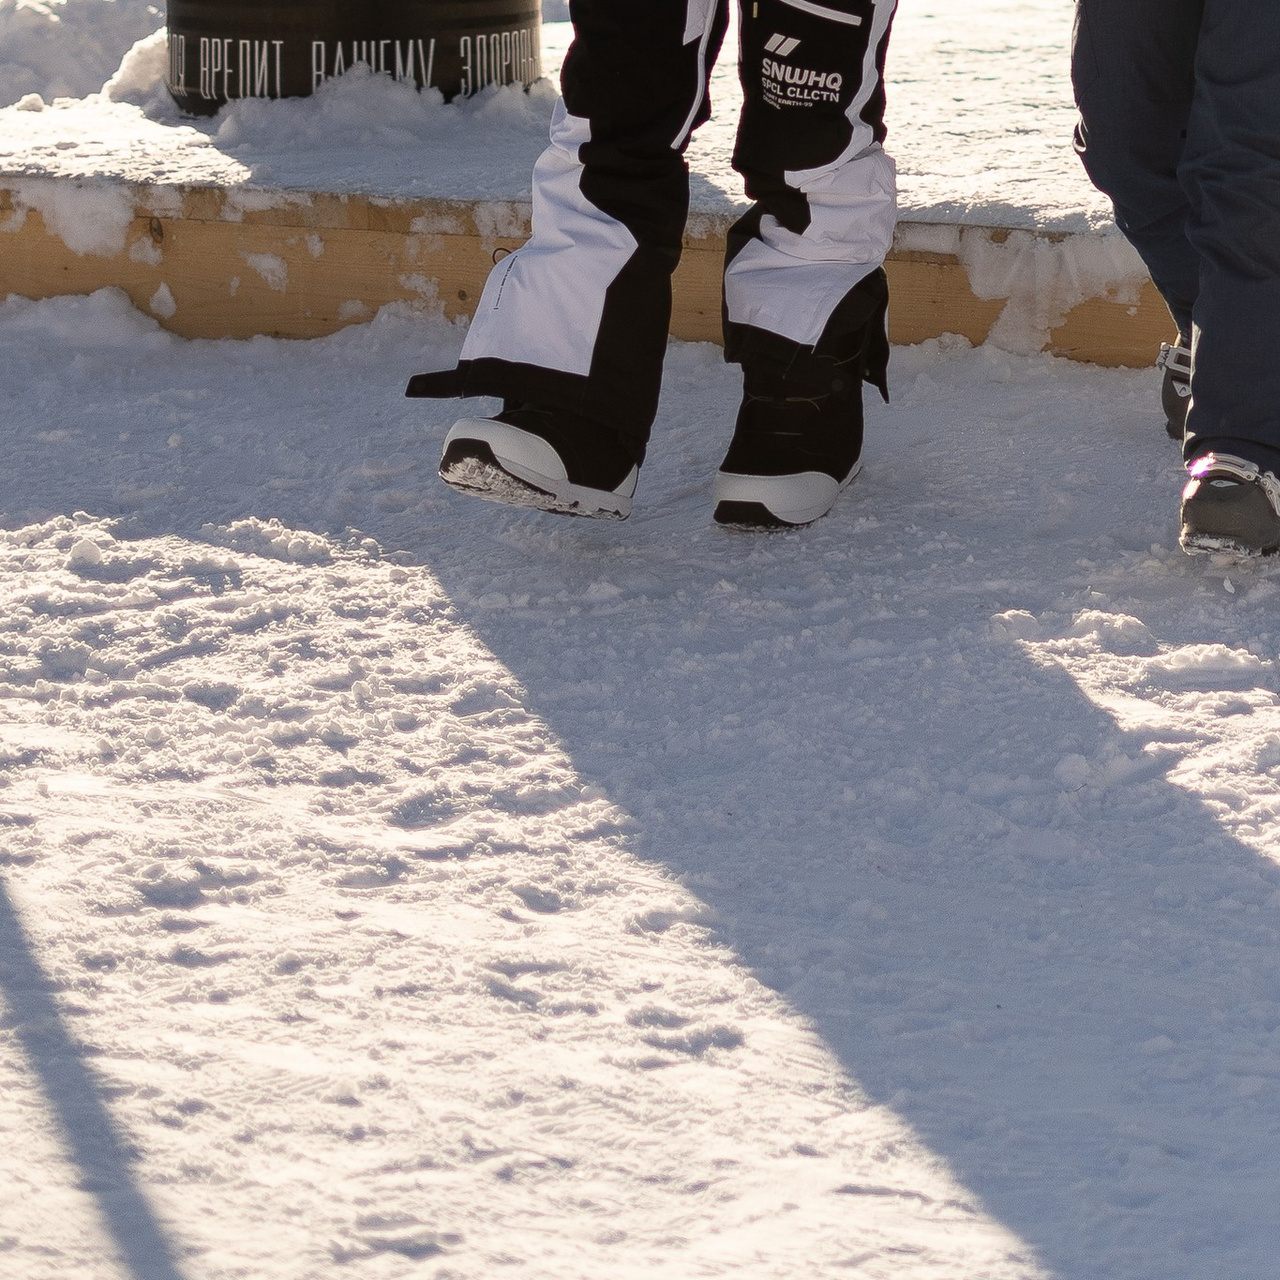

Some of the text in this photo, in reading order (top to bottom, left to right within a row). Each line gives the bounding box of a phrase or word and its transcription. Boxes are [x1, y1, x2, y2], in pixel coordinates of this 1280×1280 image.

[761, 77, 840, 103] SPCL CLLCTN
[762, 58, 843, 92] SNWHQ
